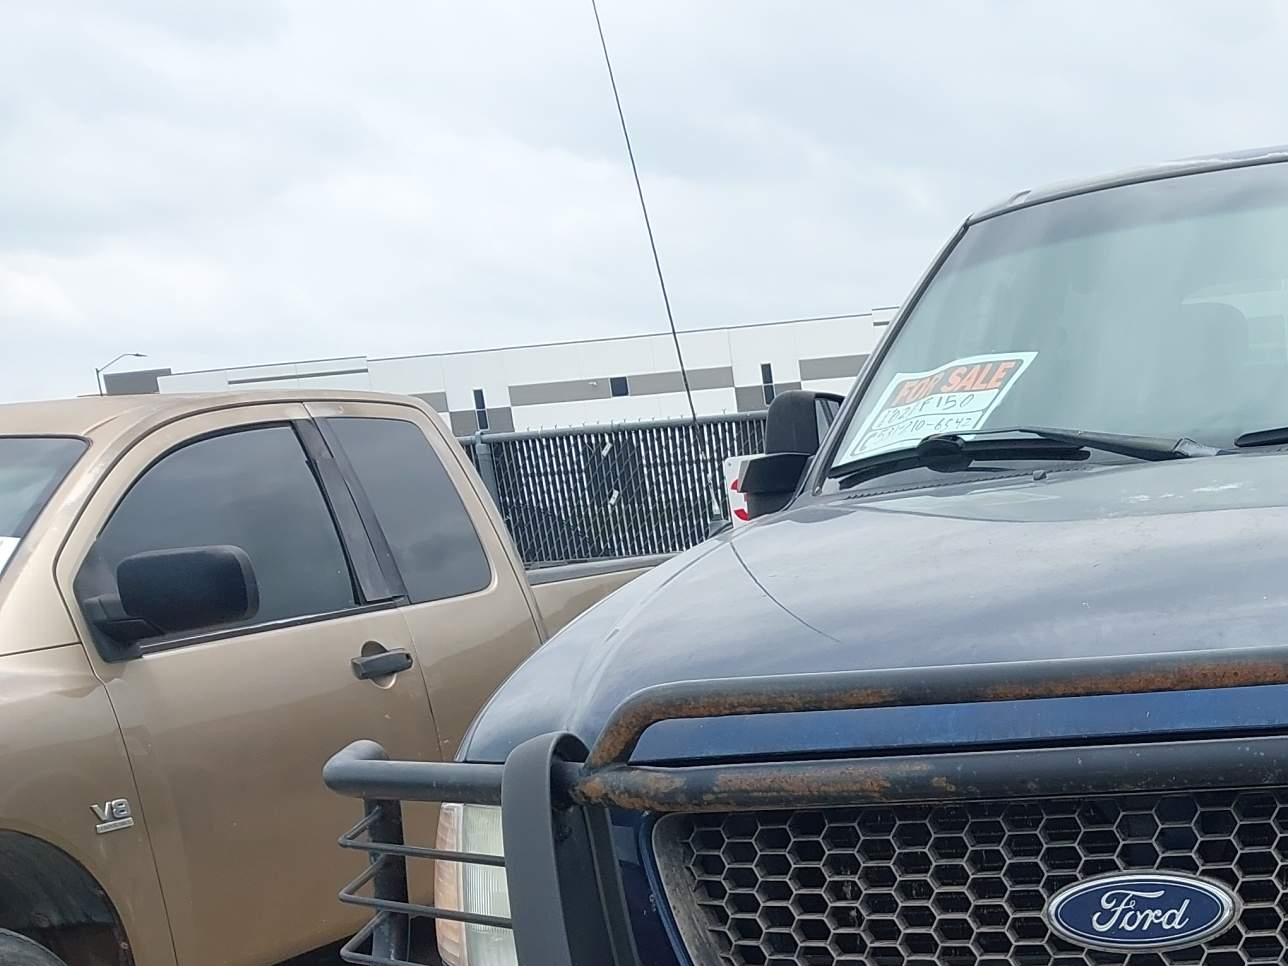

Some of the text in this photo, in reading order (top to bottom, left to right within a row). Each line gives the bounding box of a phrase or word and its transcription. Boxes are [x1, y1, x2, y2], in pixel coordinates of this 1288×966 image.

[892, 362, 1016, 406] FOR SALE
[90, 799, 131, 821] V8
[1092, 889, 1190, 932] Ford
